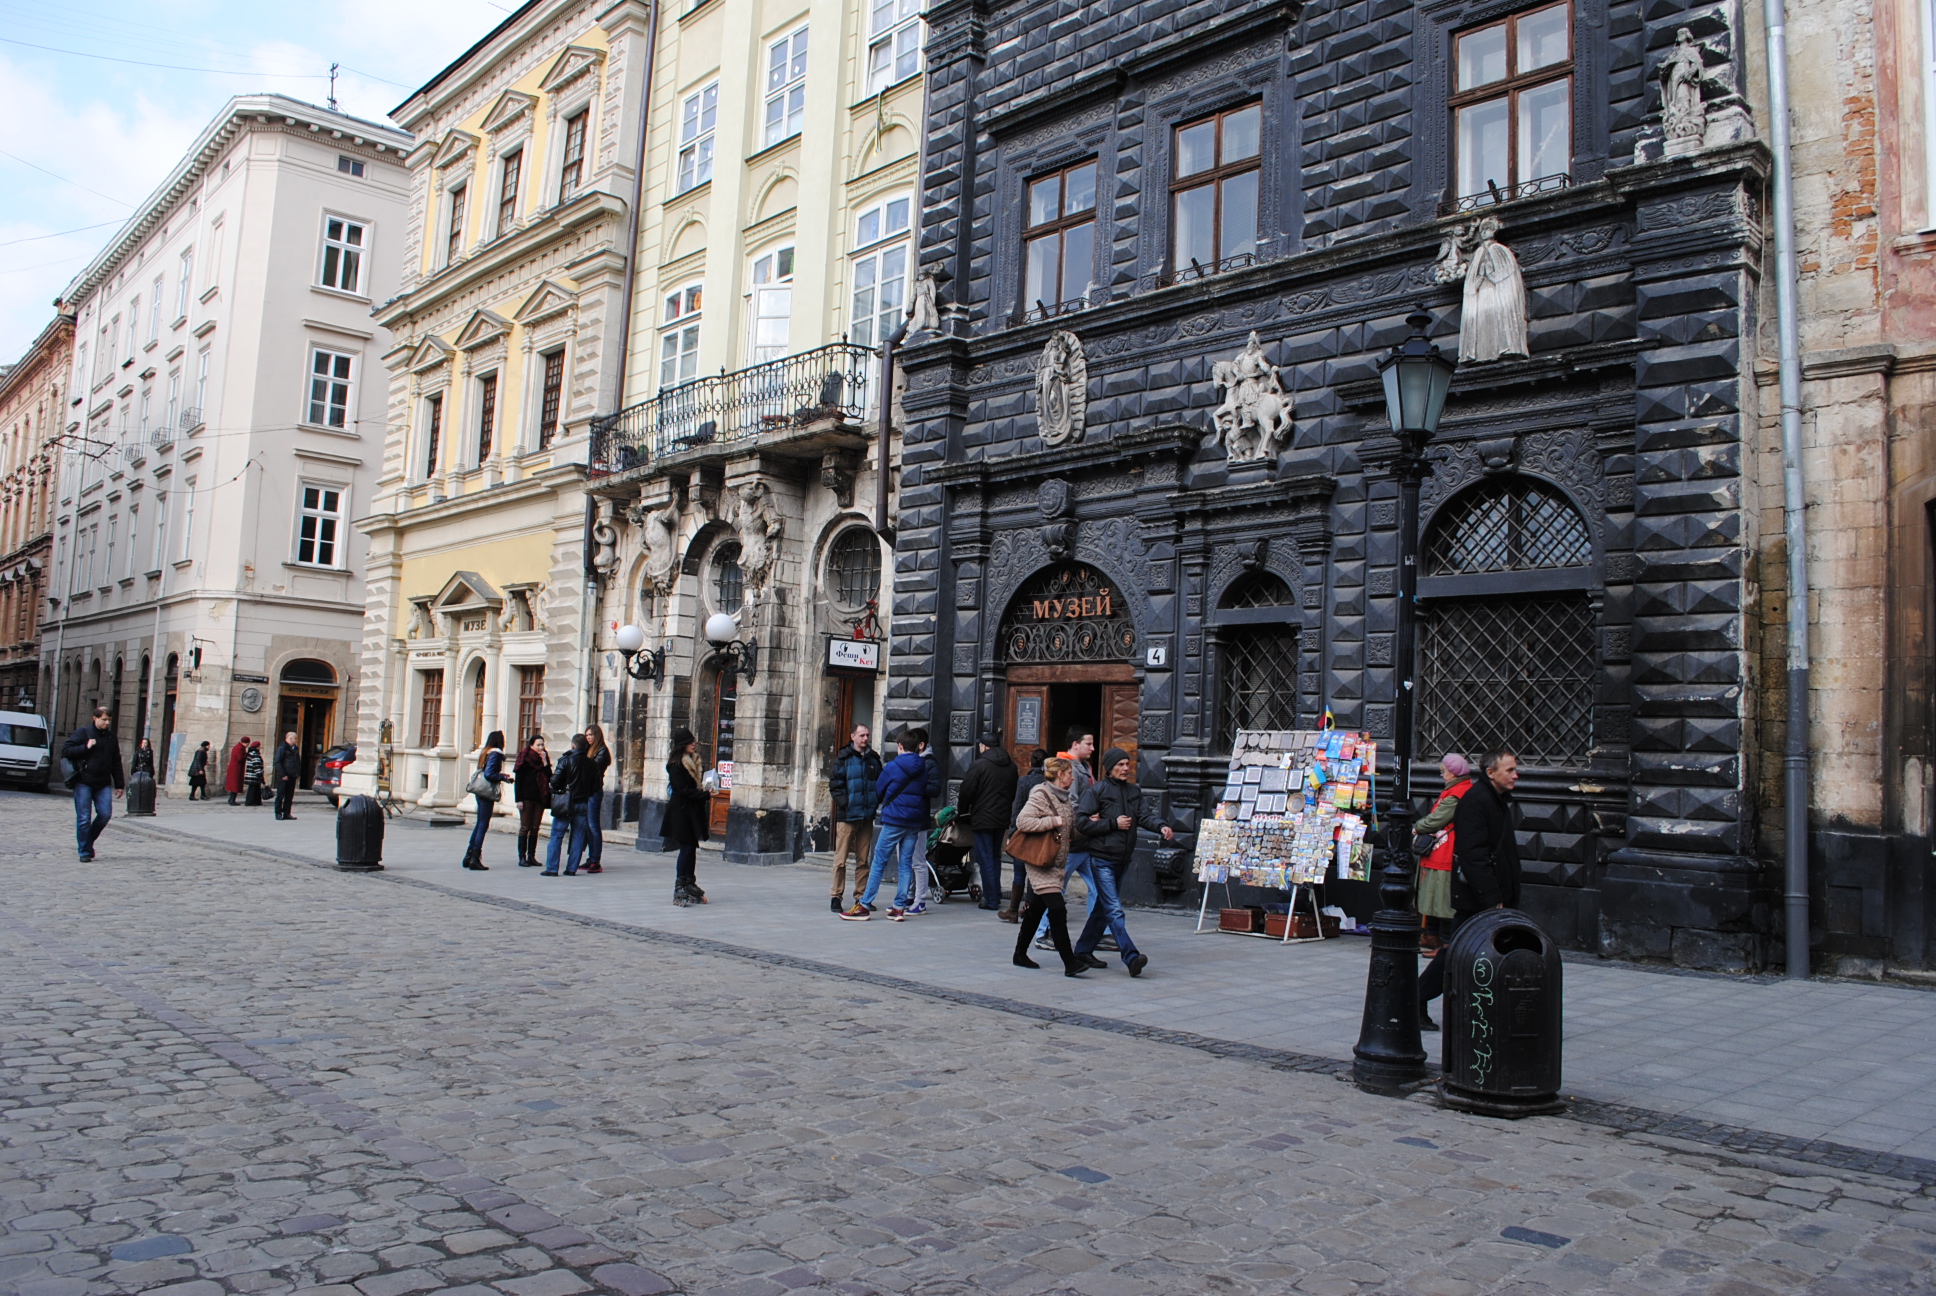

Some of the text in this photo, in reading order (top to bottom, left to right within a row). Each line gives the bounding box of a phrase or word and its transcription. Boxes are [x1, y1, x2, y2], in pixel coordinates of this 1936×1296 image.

[1033, 588, 1112, 619] МУЗЕЙ
[463, 619, 487, 632] МУЗЕ
[859, 657, 875, 666] Кет
[1152, 649, 1160, 664] 4
